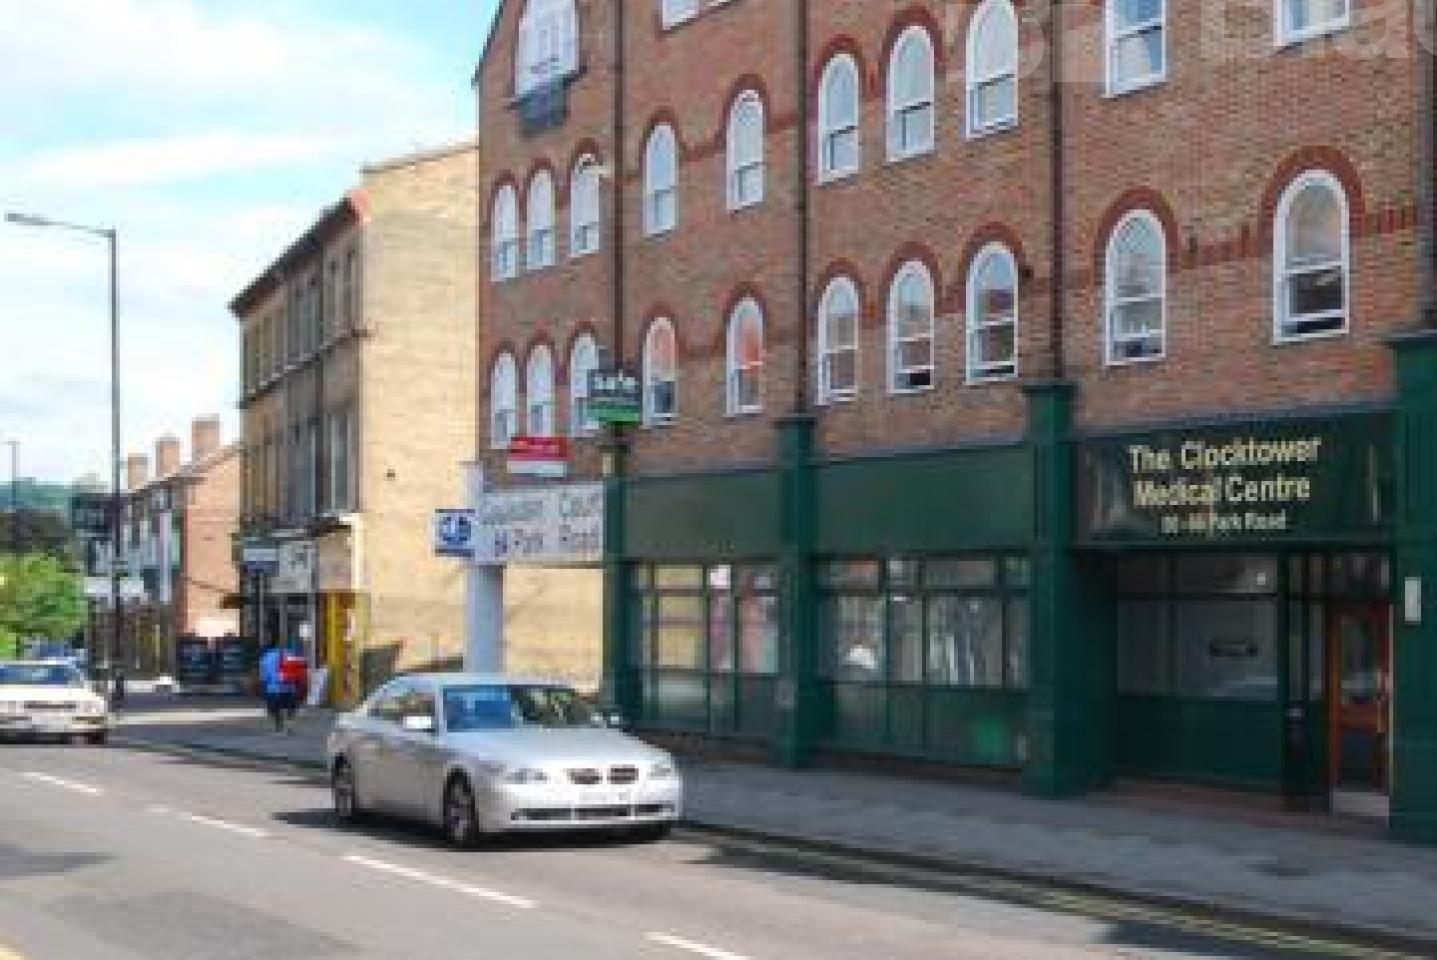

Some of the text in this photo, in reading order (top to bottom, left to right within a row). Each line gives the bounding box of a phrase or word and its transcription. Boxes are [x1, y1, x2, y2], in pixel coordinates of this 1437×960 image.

[1128, 437, 1322, 473] The Clocktower
[1133, 477, 1310, 509] Medical Centre
